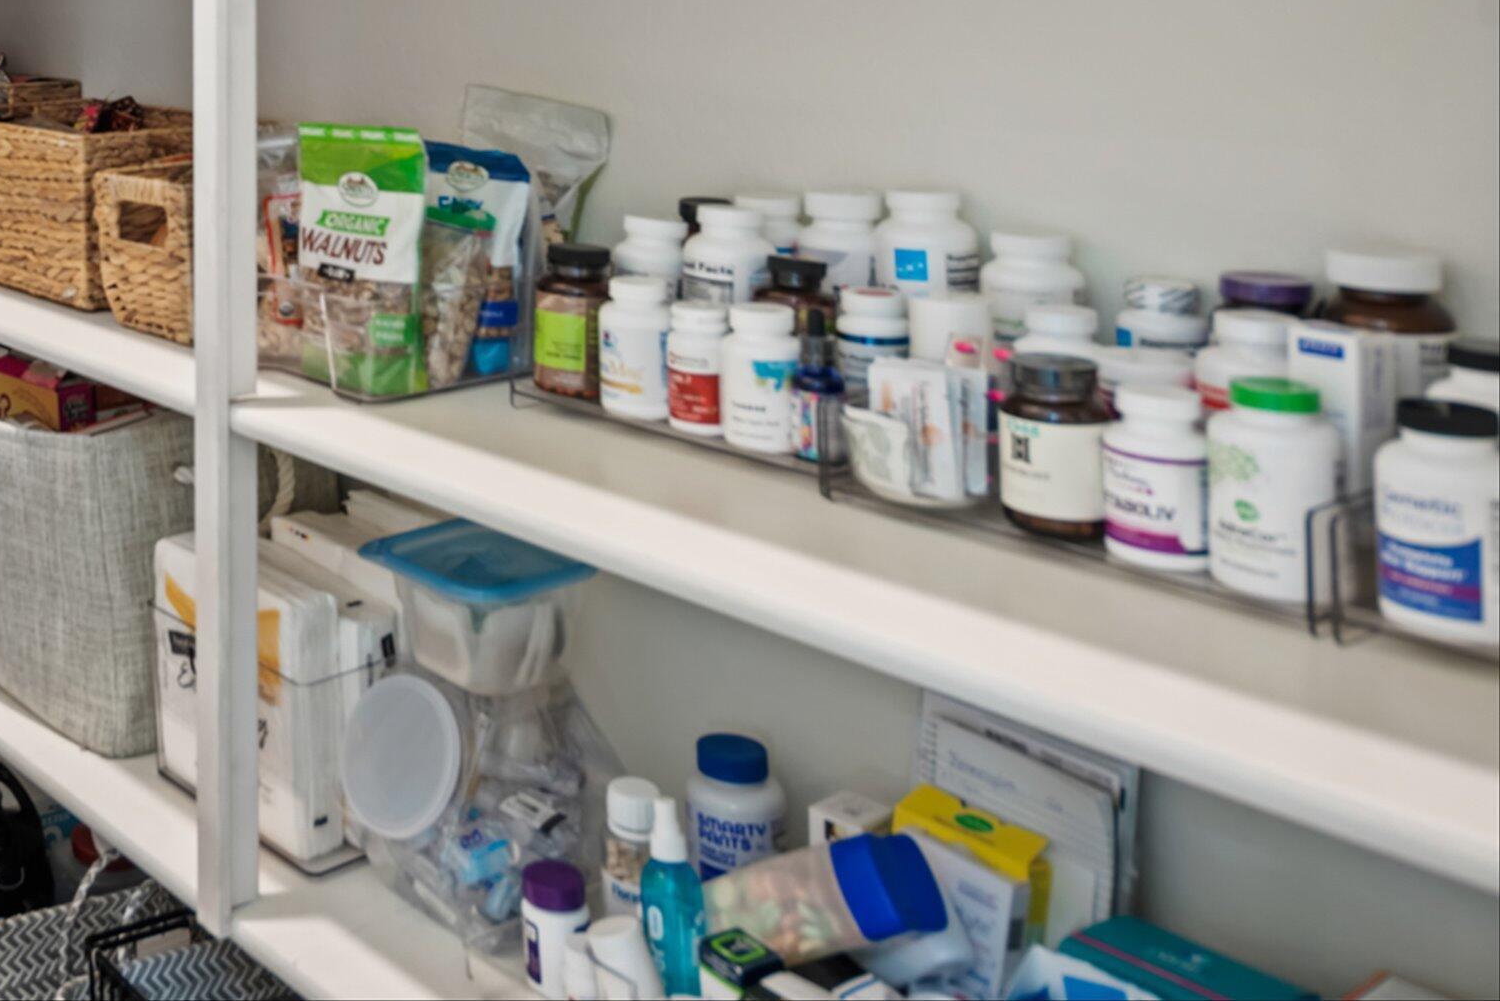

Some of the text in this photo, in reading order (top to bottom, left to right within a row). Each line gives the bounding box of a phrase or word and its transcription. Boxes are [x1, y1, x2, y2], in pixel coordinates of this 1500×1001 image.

[324, 212, 381, 236] ORGANIC
[301, 227, 388, 266] WALNUTS
[697, 812, 767, 837] SMARTY
